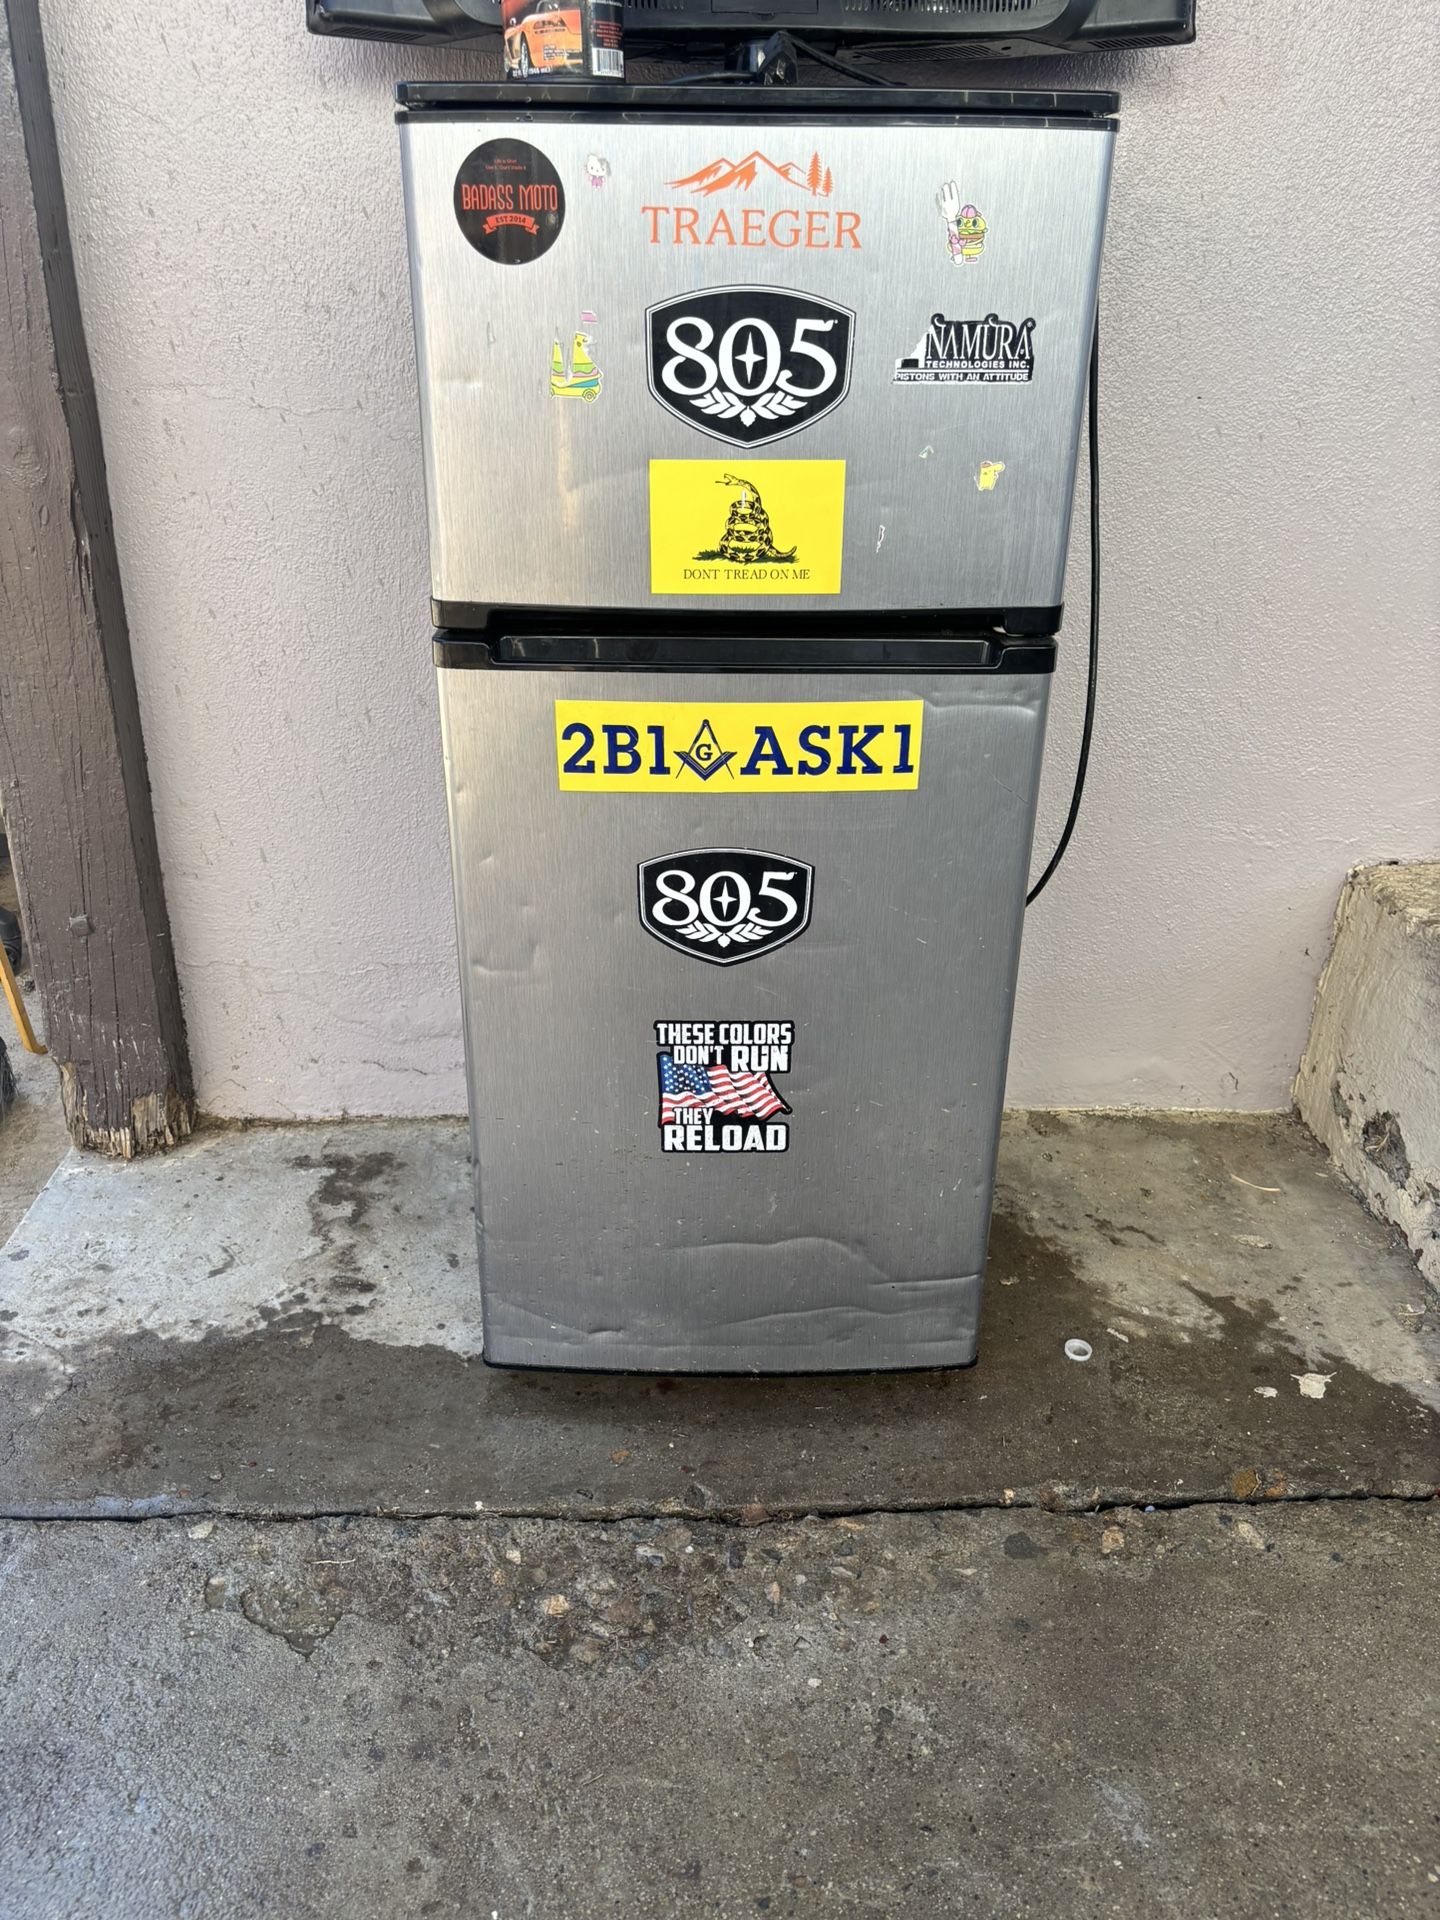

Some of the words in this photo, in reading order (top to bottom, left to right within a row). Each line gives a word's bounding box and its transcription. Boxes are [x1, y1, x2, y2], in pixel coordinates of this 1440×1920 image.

[461, 183, 514, 210] BADASS
[518, 184, 558, 211] MOTO
[495, 216, 509, 224] EST
[509, 215, 527, 224] 2014
[641, 206, 863, 249] TRAEGER
[926, 317, 1031, 360] NAMURA
[661, 316, 838, 397] 805
[925, 360, 1005, 369] TECHNOLOGIES
[1008, 360, 1030, 369] INC.
[893, 372, 935, 382] PISTONS
[938, 372, 964, 382] WITH
[966, 372, 980, 382] AN
[983, 372, 1029, 382] ATTITUDE
[683, 569, 721, 580] DONT
[723, 569, 768, 580] TREAD
[770, 569, 790, 580] ON
[792, 569, 811, 580] ME
[561, 722, 671, 775] 2B1
[695, 743, 713, 762] G
[740, 723, 914, 776] ASK1
[651, 869, 798, 928] 805
[657, 1023, 715, 1045] THESE
[719, 1023, 792, 1045] COLORS
[673, 1046, 724, 1065] DON'T
[731, 1046, 789, 1072] RUN
[673, 1107, 714, 1125] THEY
[663, 1125, 787, 1151] RELOAD
